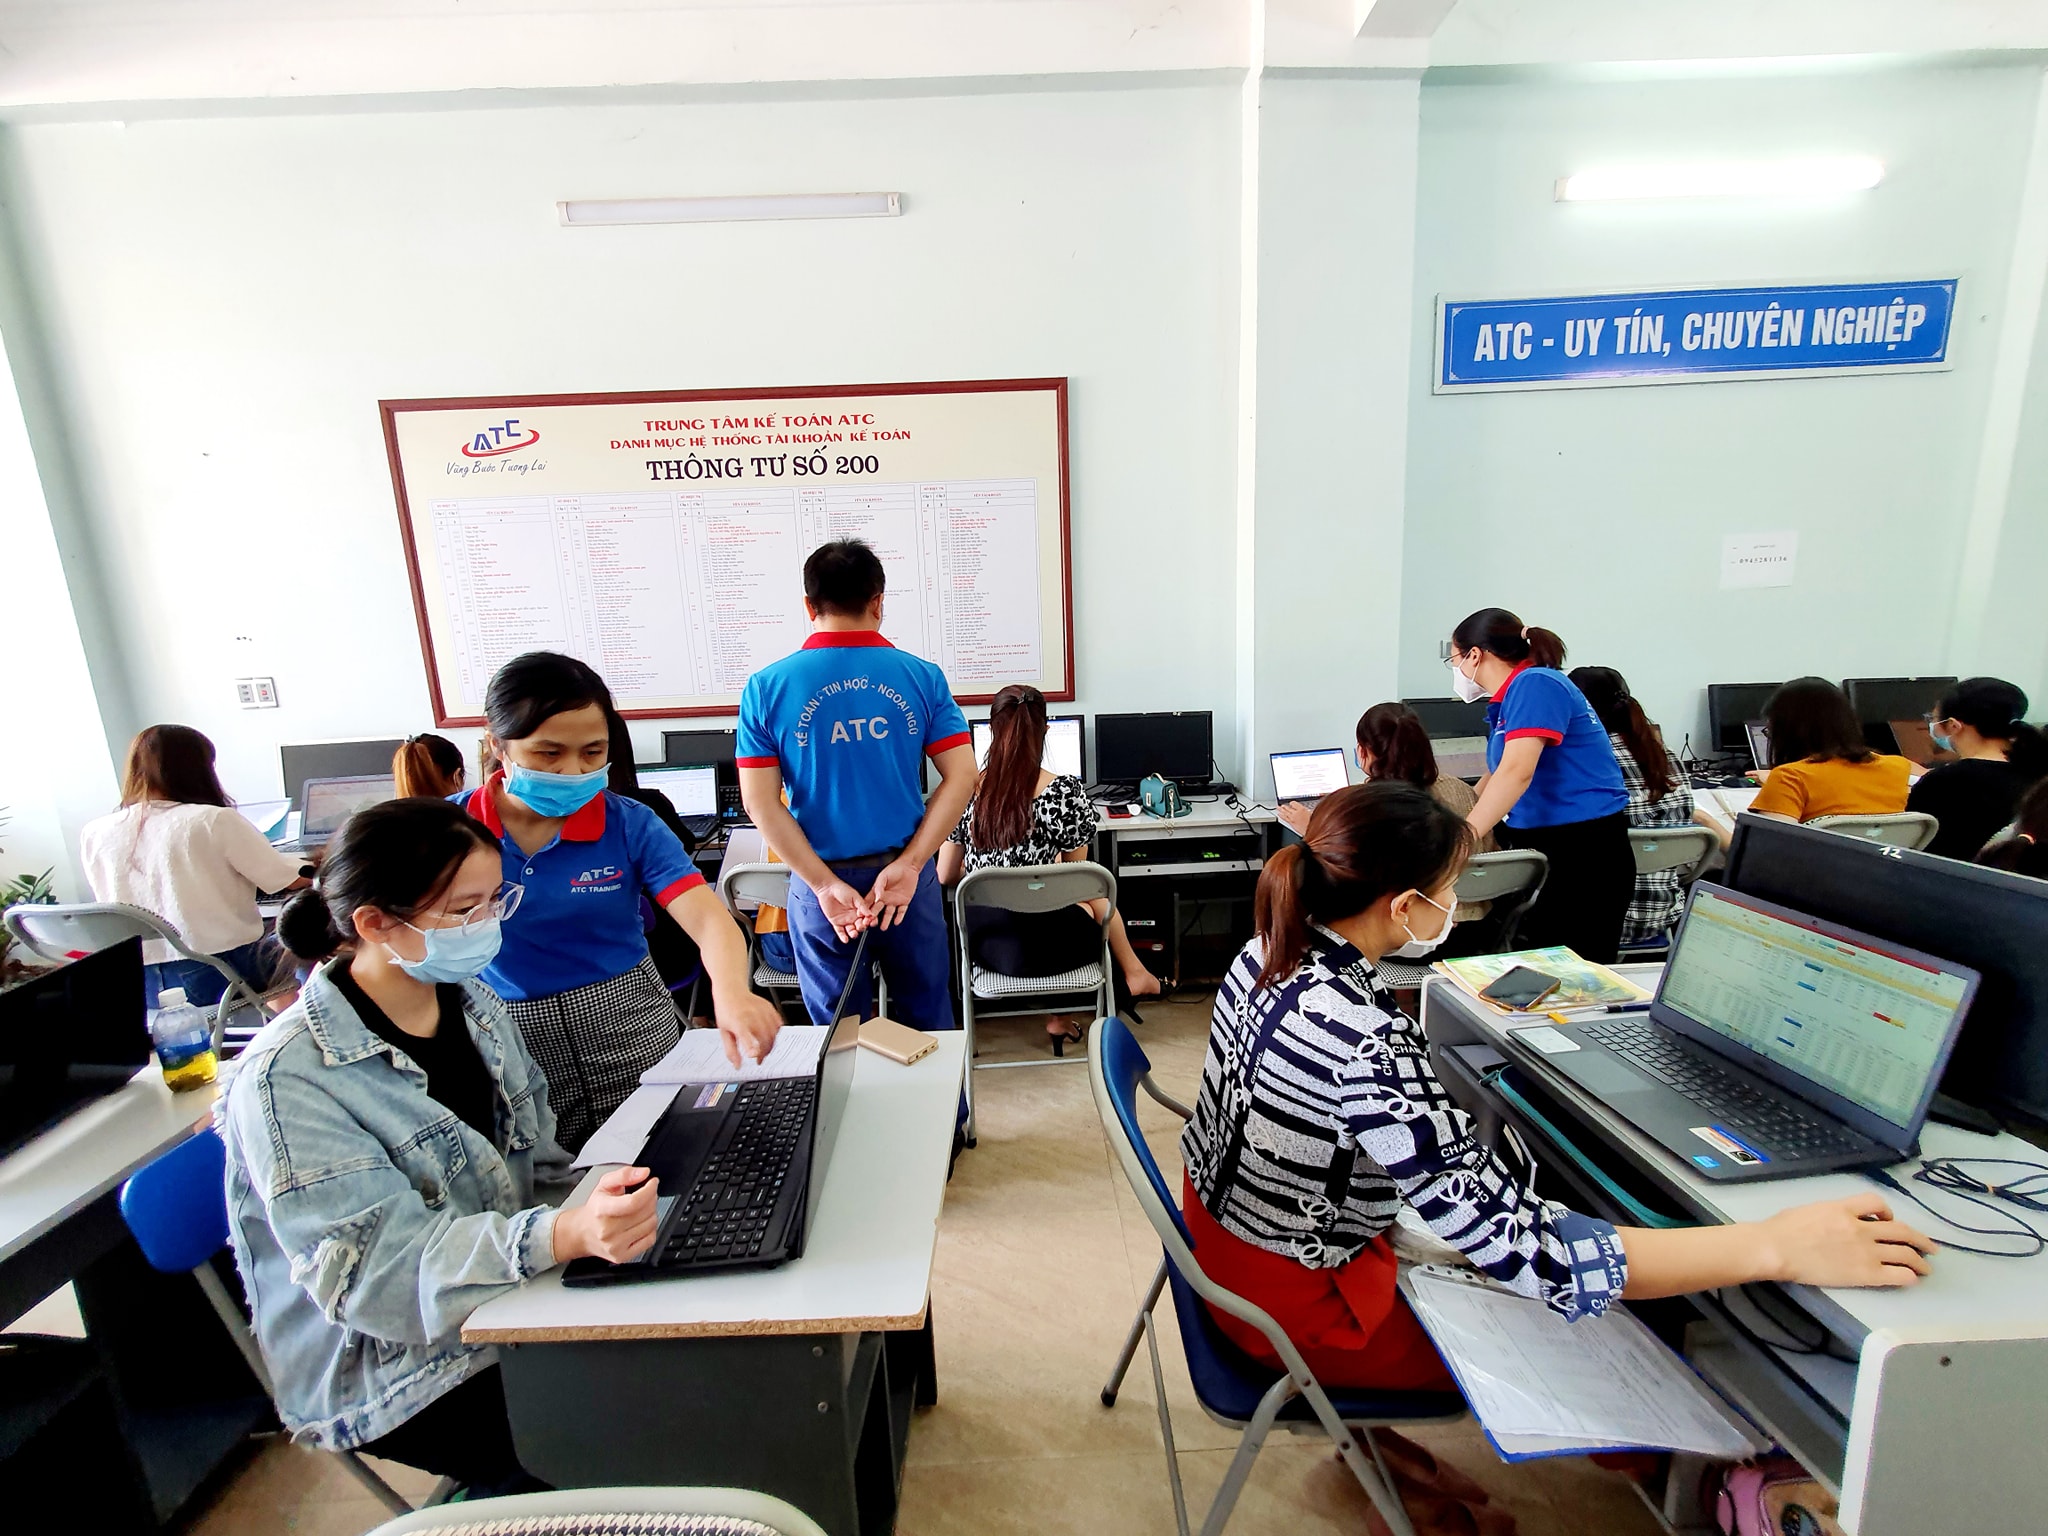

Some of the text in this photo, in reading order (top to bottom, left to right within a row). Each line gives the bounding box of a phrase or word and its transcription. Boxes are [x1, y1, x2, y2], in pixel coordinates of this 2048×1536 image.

[1473, 297, 1926, 361] ATC - UY TÍN, CHUYÊN NGHIỆP
[473, 419, 522, 451] ATC
[643, 412, 875, 431] TRUNG TÂM KẾ TOÁN ATC
[610, 428, 911, 450] DANH MỤC HỆ THỐNG TÀI KHOẢN KẾ TOÁN
[531, 459, 548, 471] Lai
[645, 445, 879, 480] THÔNG TƯ SỐ 200
[798, 698, 820, 728] TOÁN
[822, 682, 842, 697] TIN
[843, 678, 869, 691] HỌC
[877, 683, 910, 712] NGOẠI
[830, 716, 889, 744] ATC
[1878, 846, 1902, 859] 12
[579, 866, 615, 881] ATC
[1250, 1051, 1264, 1084] CHANEL
[1217, 1185, 1232, 1214] CHANEL
